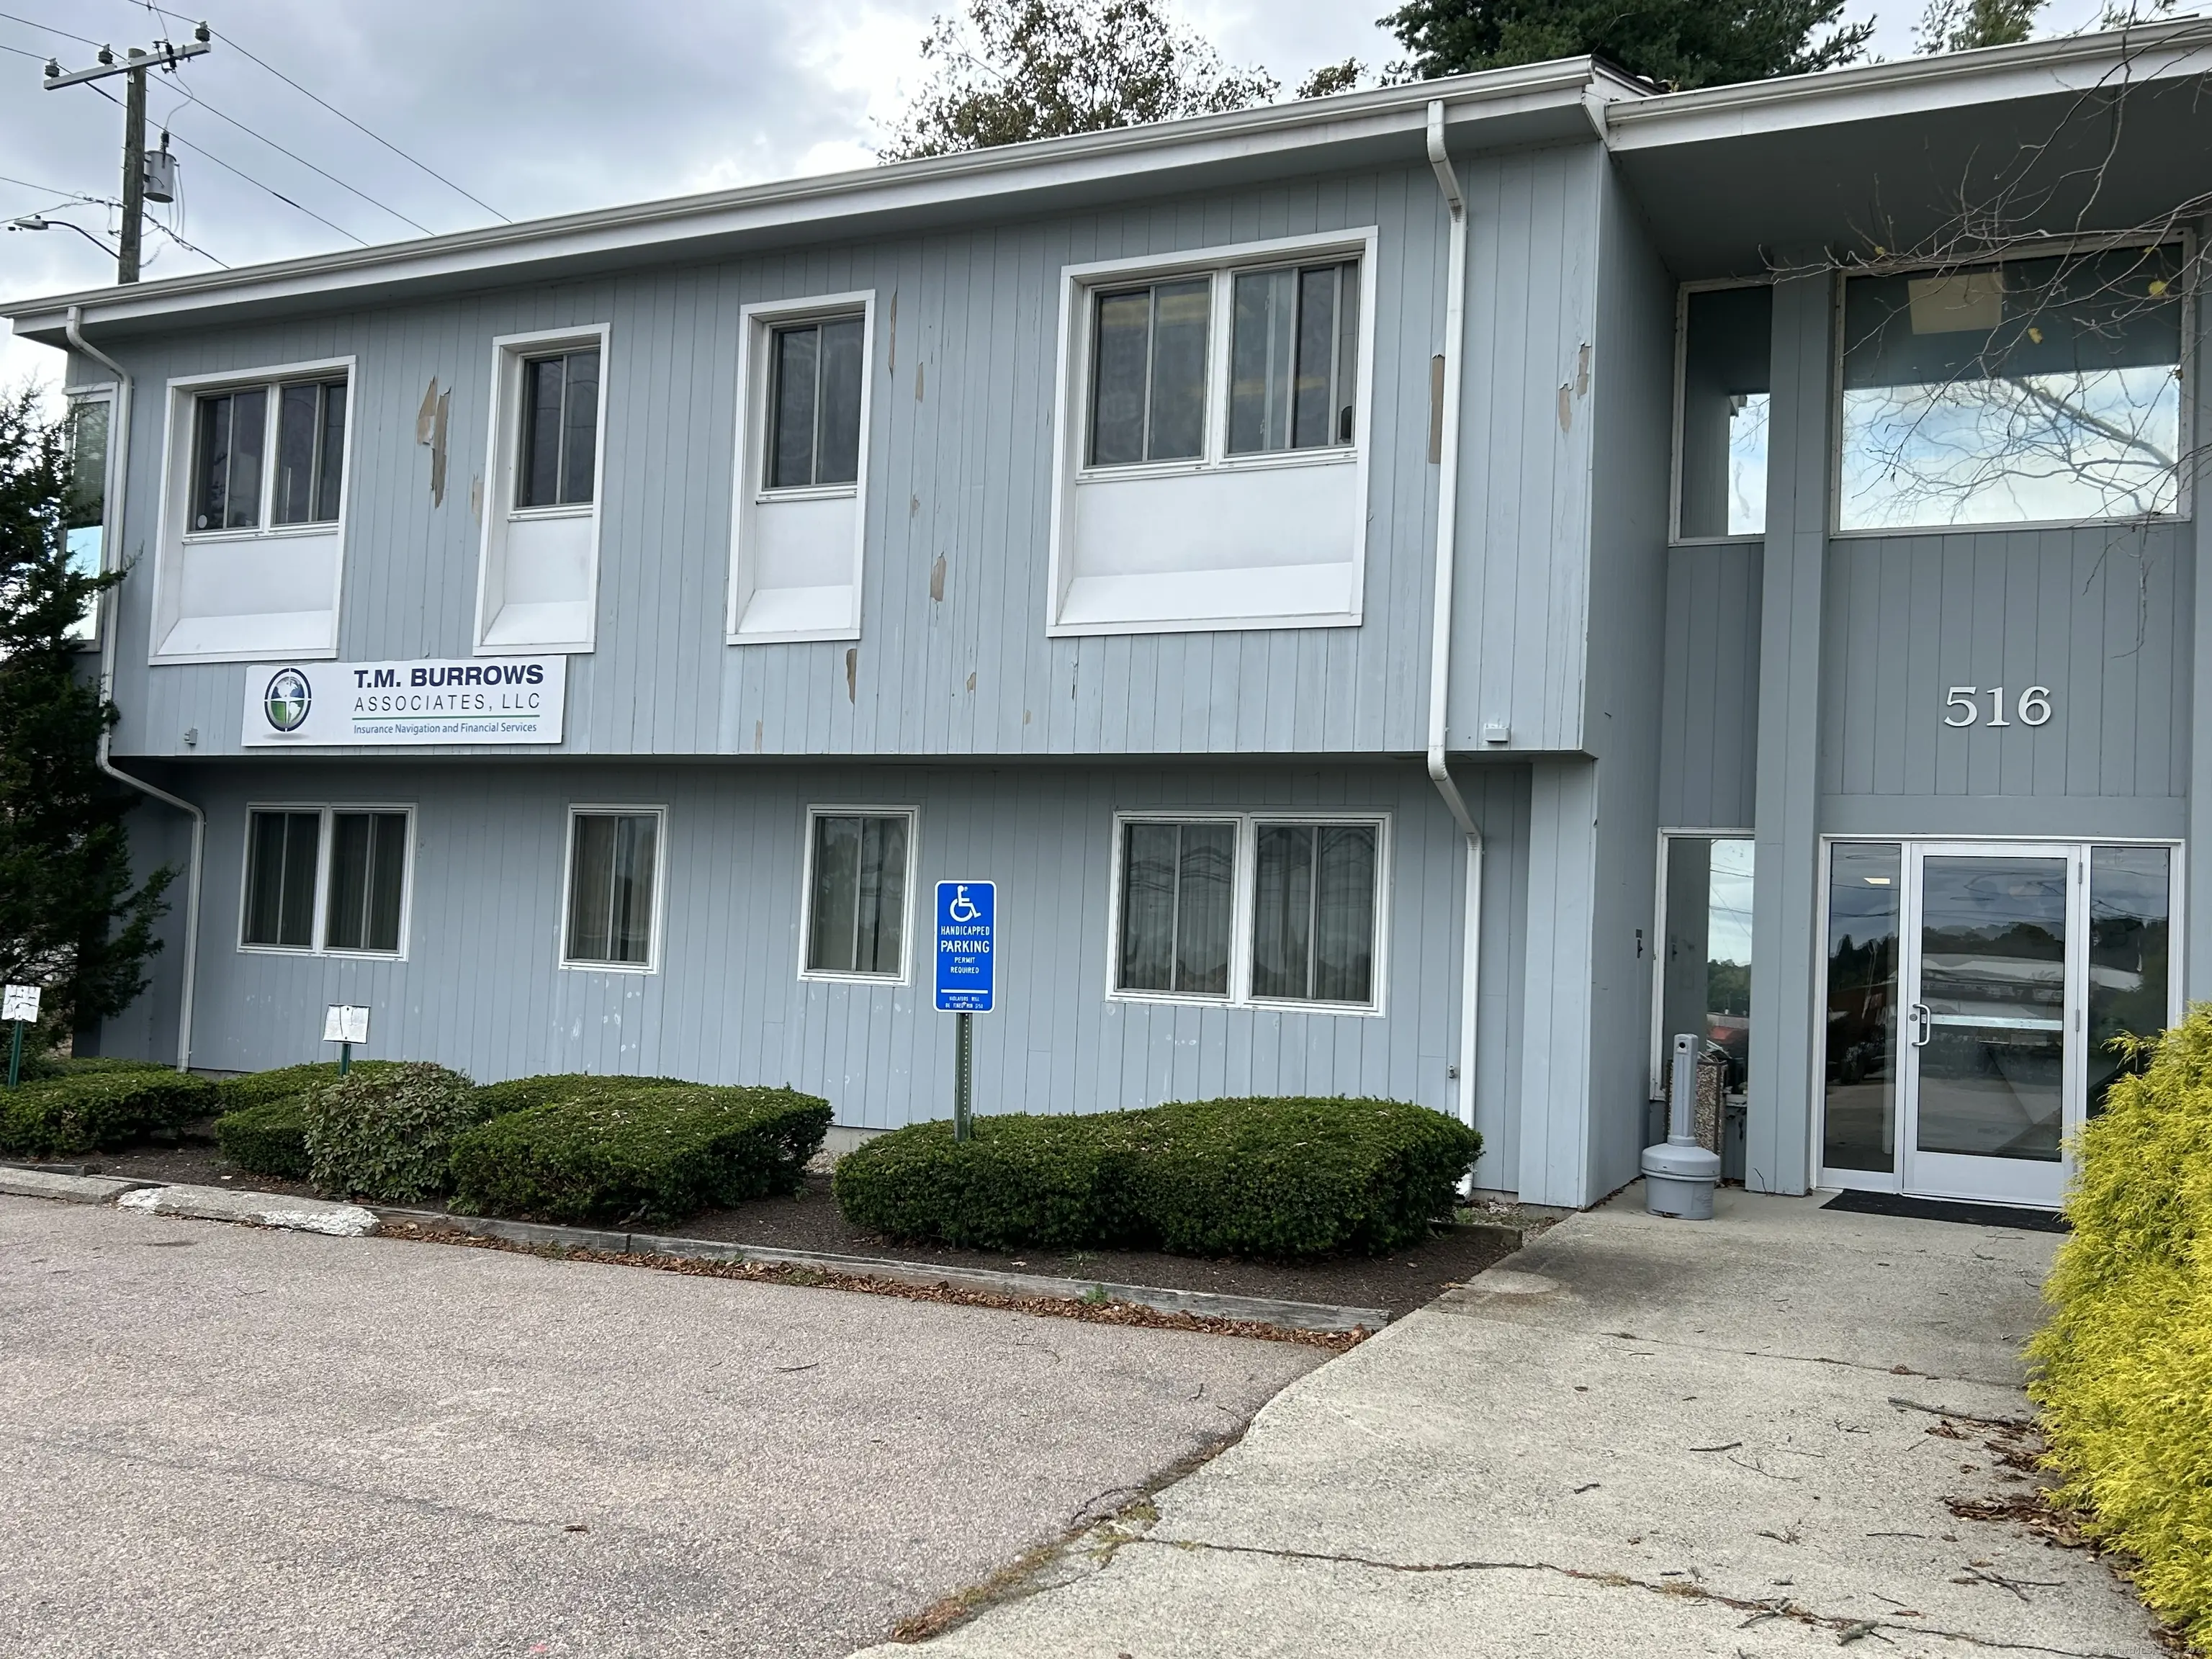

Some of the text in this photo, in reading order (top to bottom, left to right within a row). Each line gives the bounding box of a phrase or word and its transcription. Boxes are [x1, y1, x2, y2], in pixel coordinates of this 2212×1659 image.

[354, 665, 544, 688] T.M. BURROWS
[354, 693, 540, 711] ASSOCIATES, LLC
[1944, 686, 2051, 727] 516
[354, 721, 537, 735] Insurance Navigation and Financial Services
[941, 925, 990, 936] HANDICAPPED
[941, 940, 990, 953] PARKING
